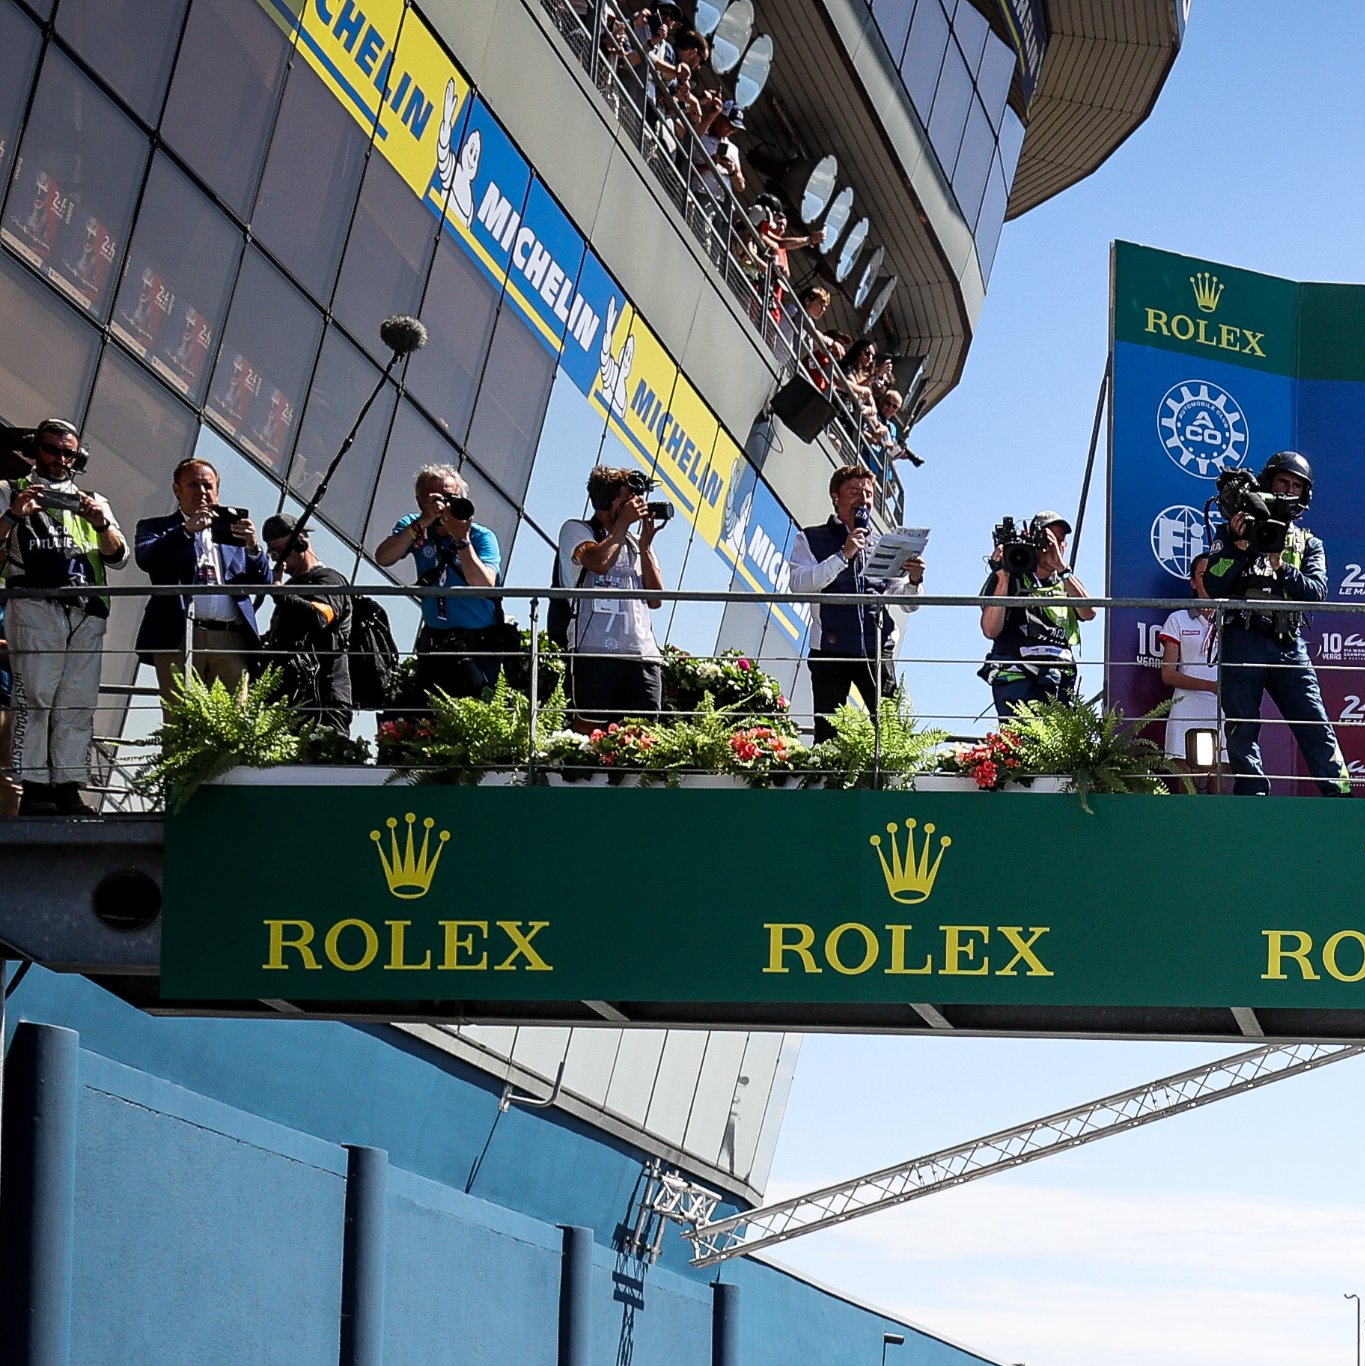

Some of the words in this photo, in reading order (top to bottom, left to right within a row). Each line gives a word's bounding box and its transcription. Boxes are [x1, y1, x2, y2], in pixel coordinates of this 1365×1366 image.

[477, 181, 602, 353] MICHELIN
[1145, 308, 1266, 357] ROLEX
[630, 378, 724, 508] MICHELIN
[1322, 633, 1341, 653] 10
[262, 919, 554, 972] ROLEX
[762, 922, 1055, 977] ROLEX
